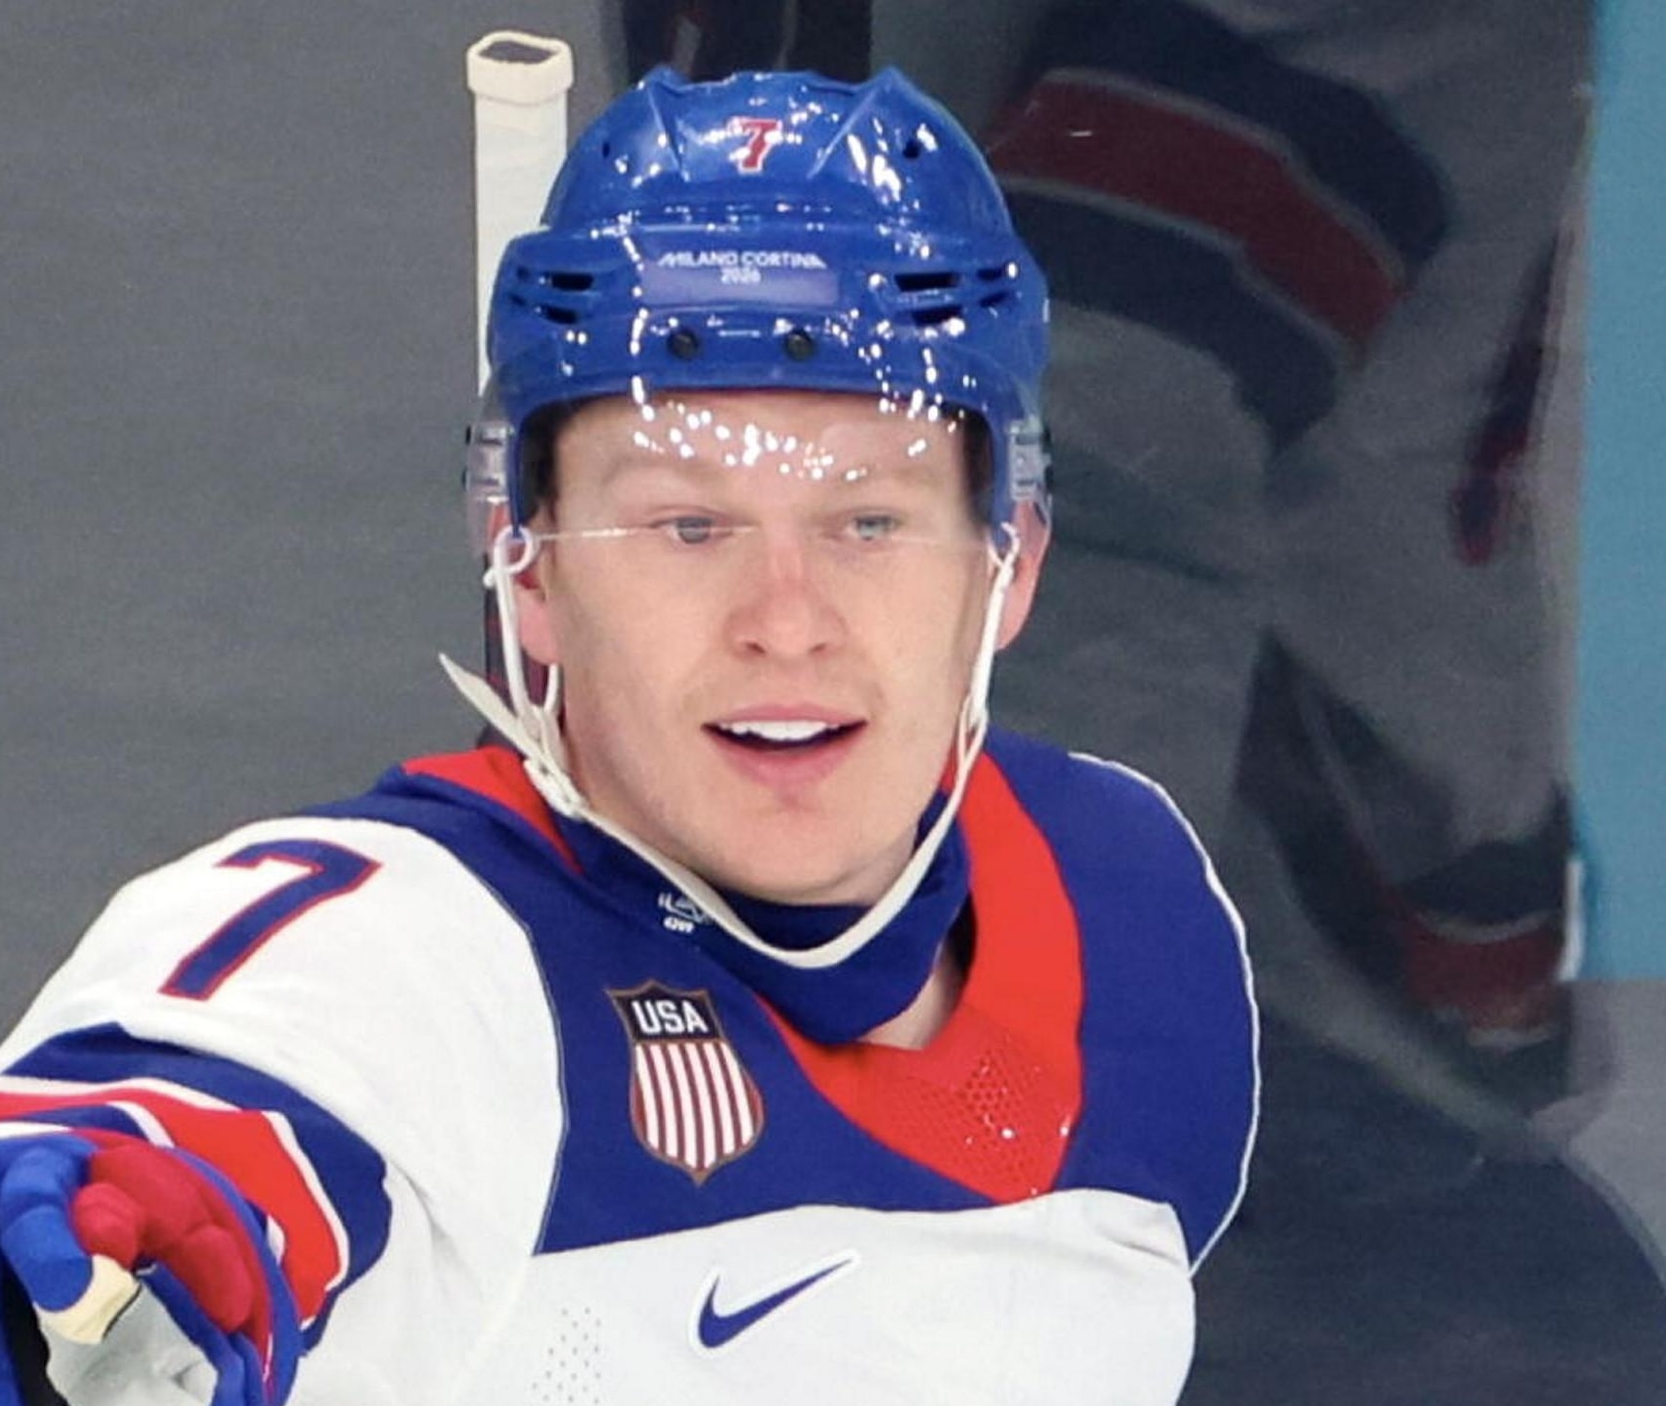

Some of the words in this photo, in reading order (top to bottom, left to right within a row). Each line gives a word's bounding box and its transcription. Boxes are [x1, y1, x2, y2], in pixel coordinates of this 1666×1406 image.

[729, 116, 783, 173] 7
[658, 251, 738, 268] MILANO
[740, 251, 827, 270] CORTINA
[157, 838, 383, 1002] 7
[632, 999, 709, 1034] USA
